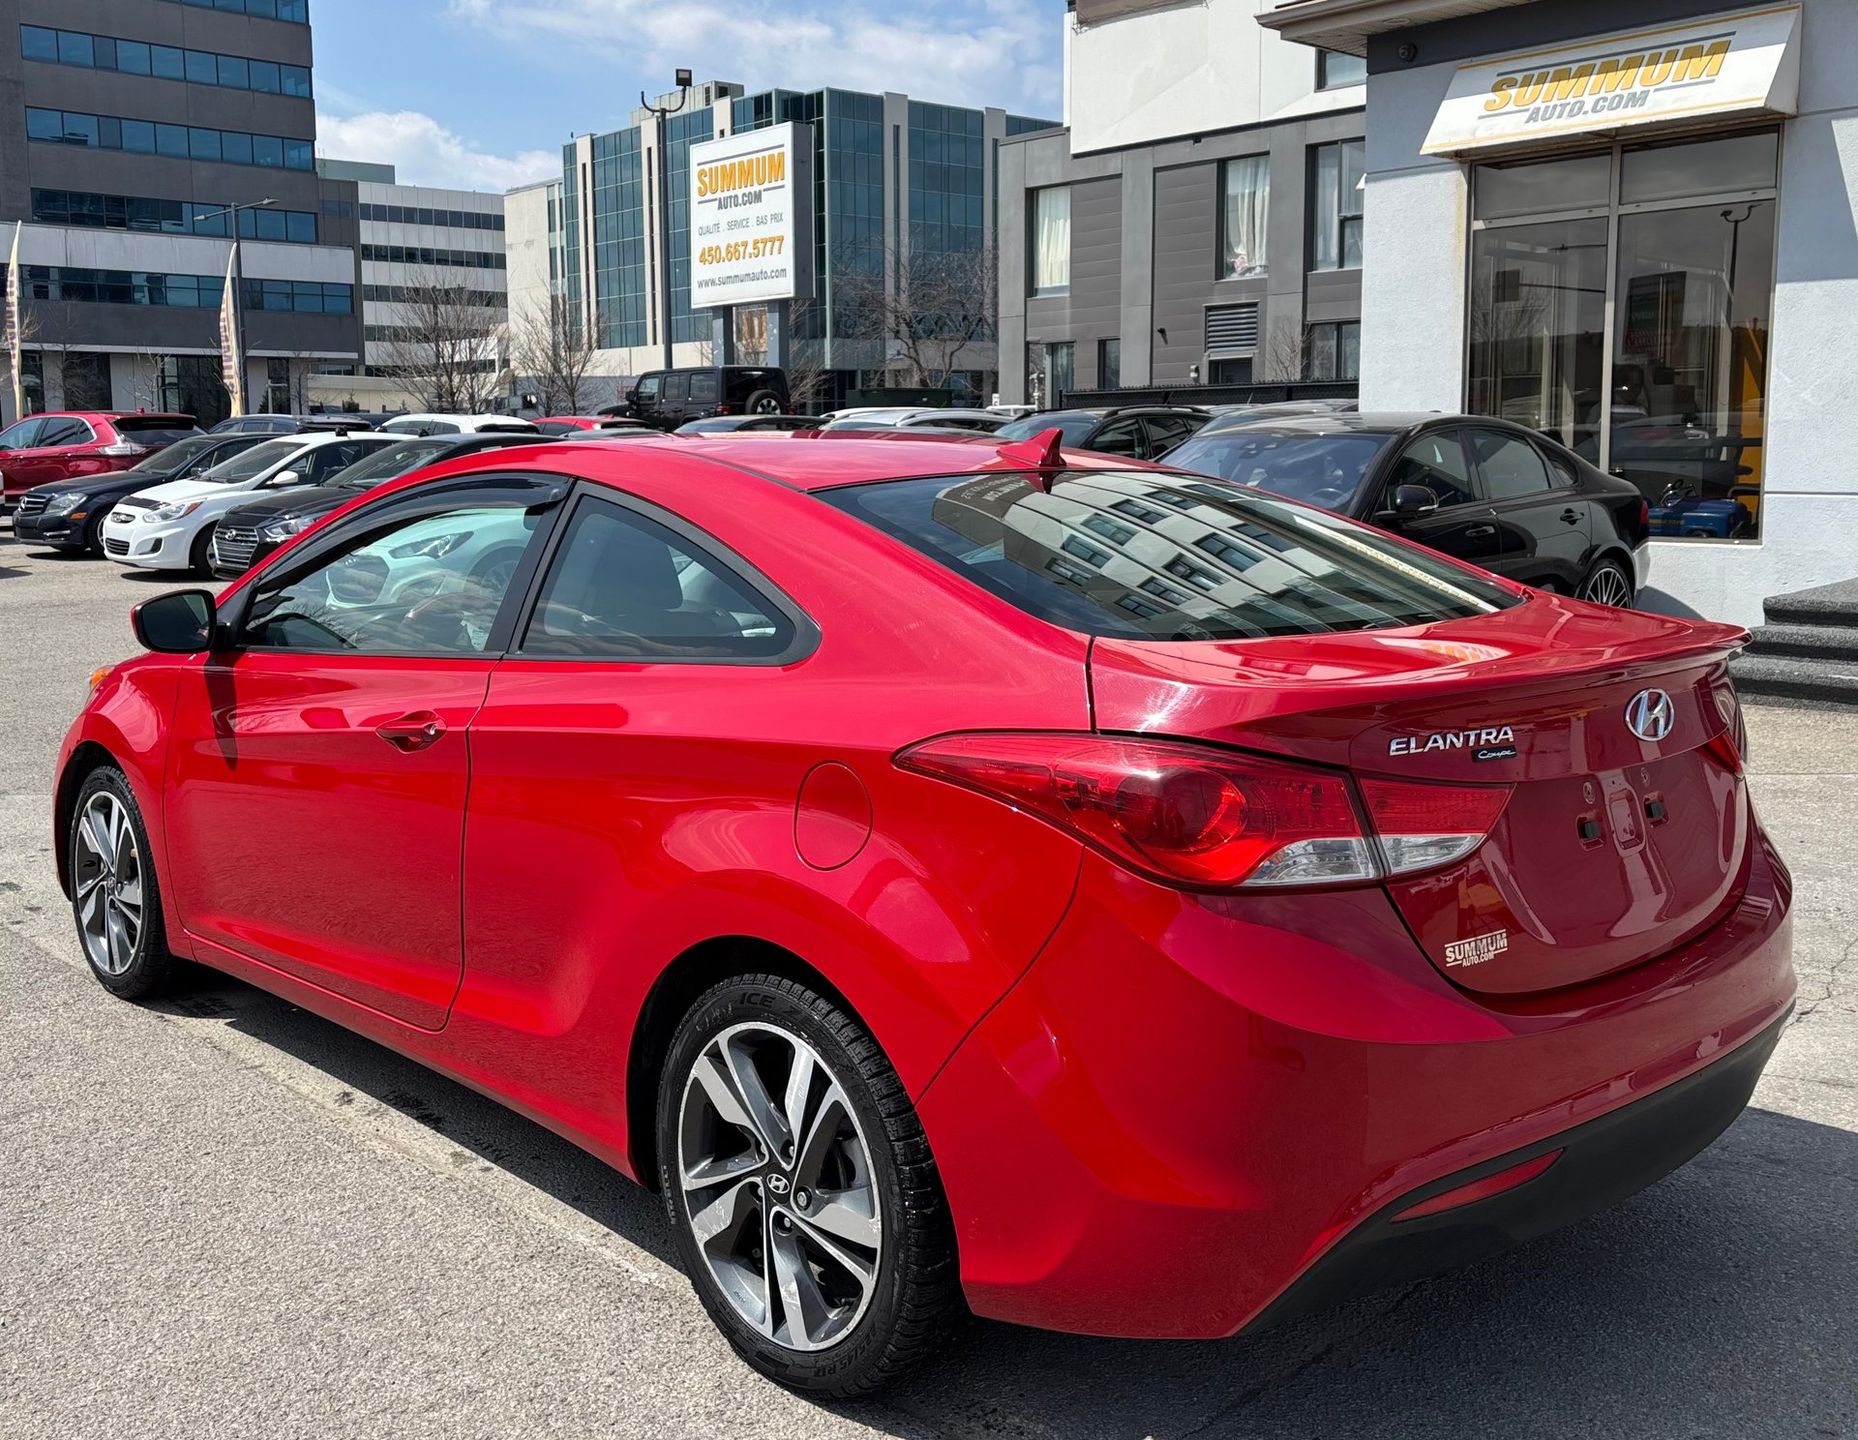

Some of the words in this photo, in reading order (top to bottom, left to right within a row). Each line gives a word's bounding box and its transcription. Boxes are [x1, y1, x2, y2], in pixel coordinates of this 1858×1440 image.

[1483, 39, 1732, 112] SUMMUM
[1525, 90, 1651, 124] AUTO.COM
[697, 151, 785, 197] SUMMUM
[717, 189, 763, 211] AUTO.COM
[726, 217, 750, 231] SERVICE
[755, 214, 768, 226] BAS
[769, 212, 784, 224] PRIX
[698, 235, 784, 265] 450.667.5777
[697, 267, 787, 289] www.summumauto.com
[1388, 725, 1515, 756] ELANTRA
[1477, 748, 1517, 760] Coupe
[1445, 932, 1508, 963] SUMMUM
[1462, 951, 1495, 968] AUTO.COM
[739, 991, 777, 1010] ICE
